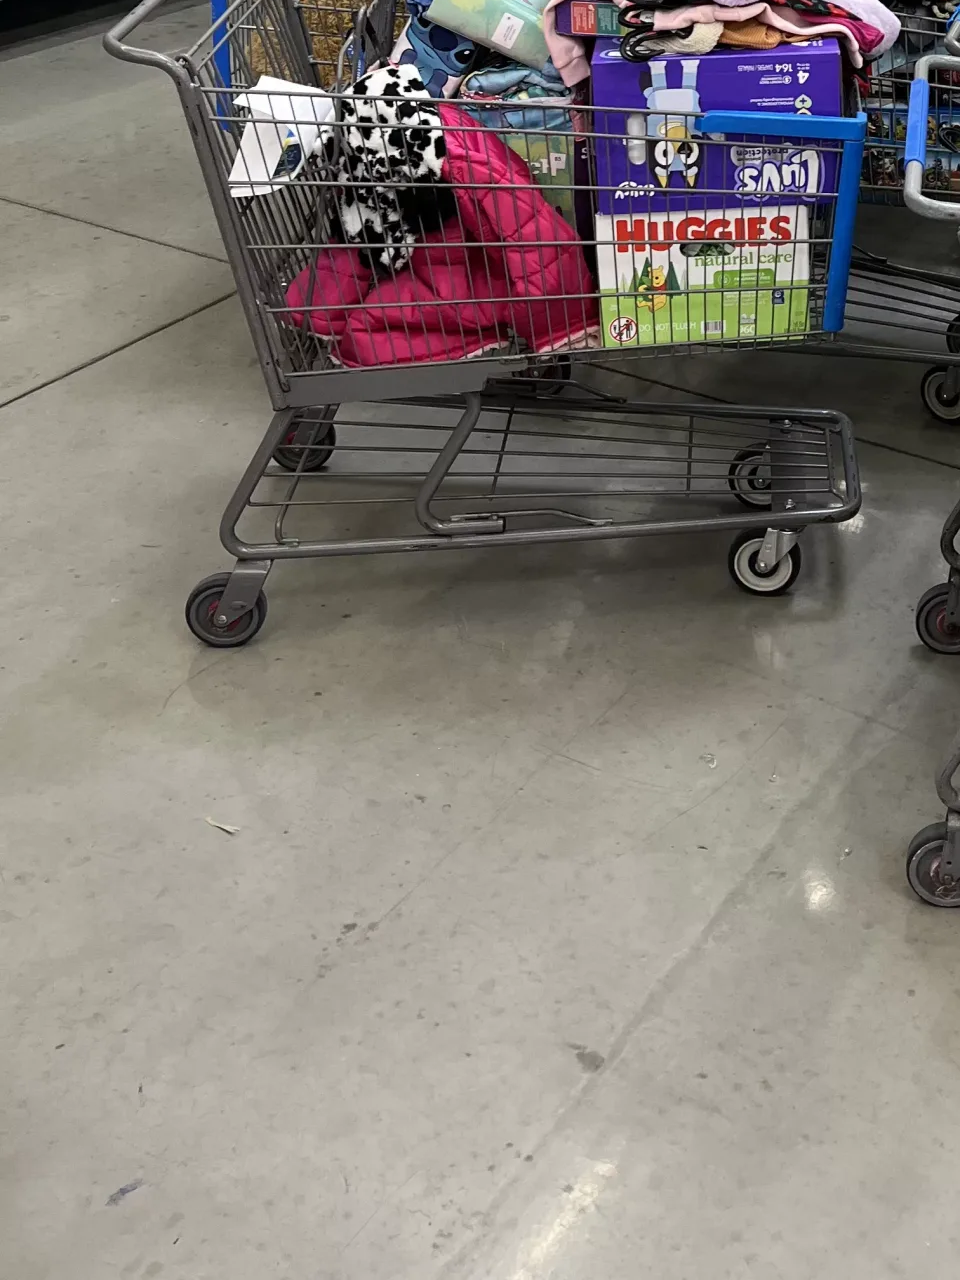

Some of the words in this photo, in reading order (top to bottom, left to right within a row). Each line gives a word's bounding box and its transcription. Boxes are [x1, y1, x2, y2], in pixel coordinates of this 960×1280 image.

[775, 64, 793, 72] 164
[797, 70, 809, 84] 4
[616, 216, 792, 253] HUGGIES
[694, 251, 754, 267] natural
[758, 252, 792, 264] care
